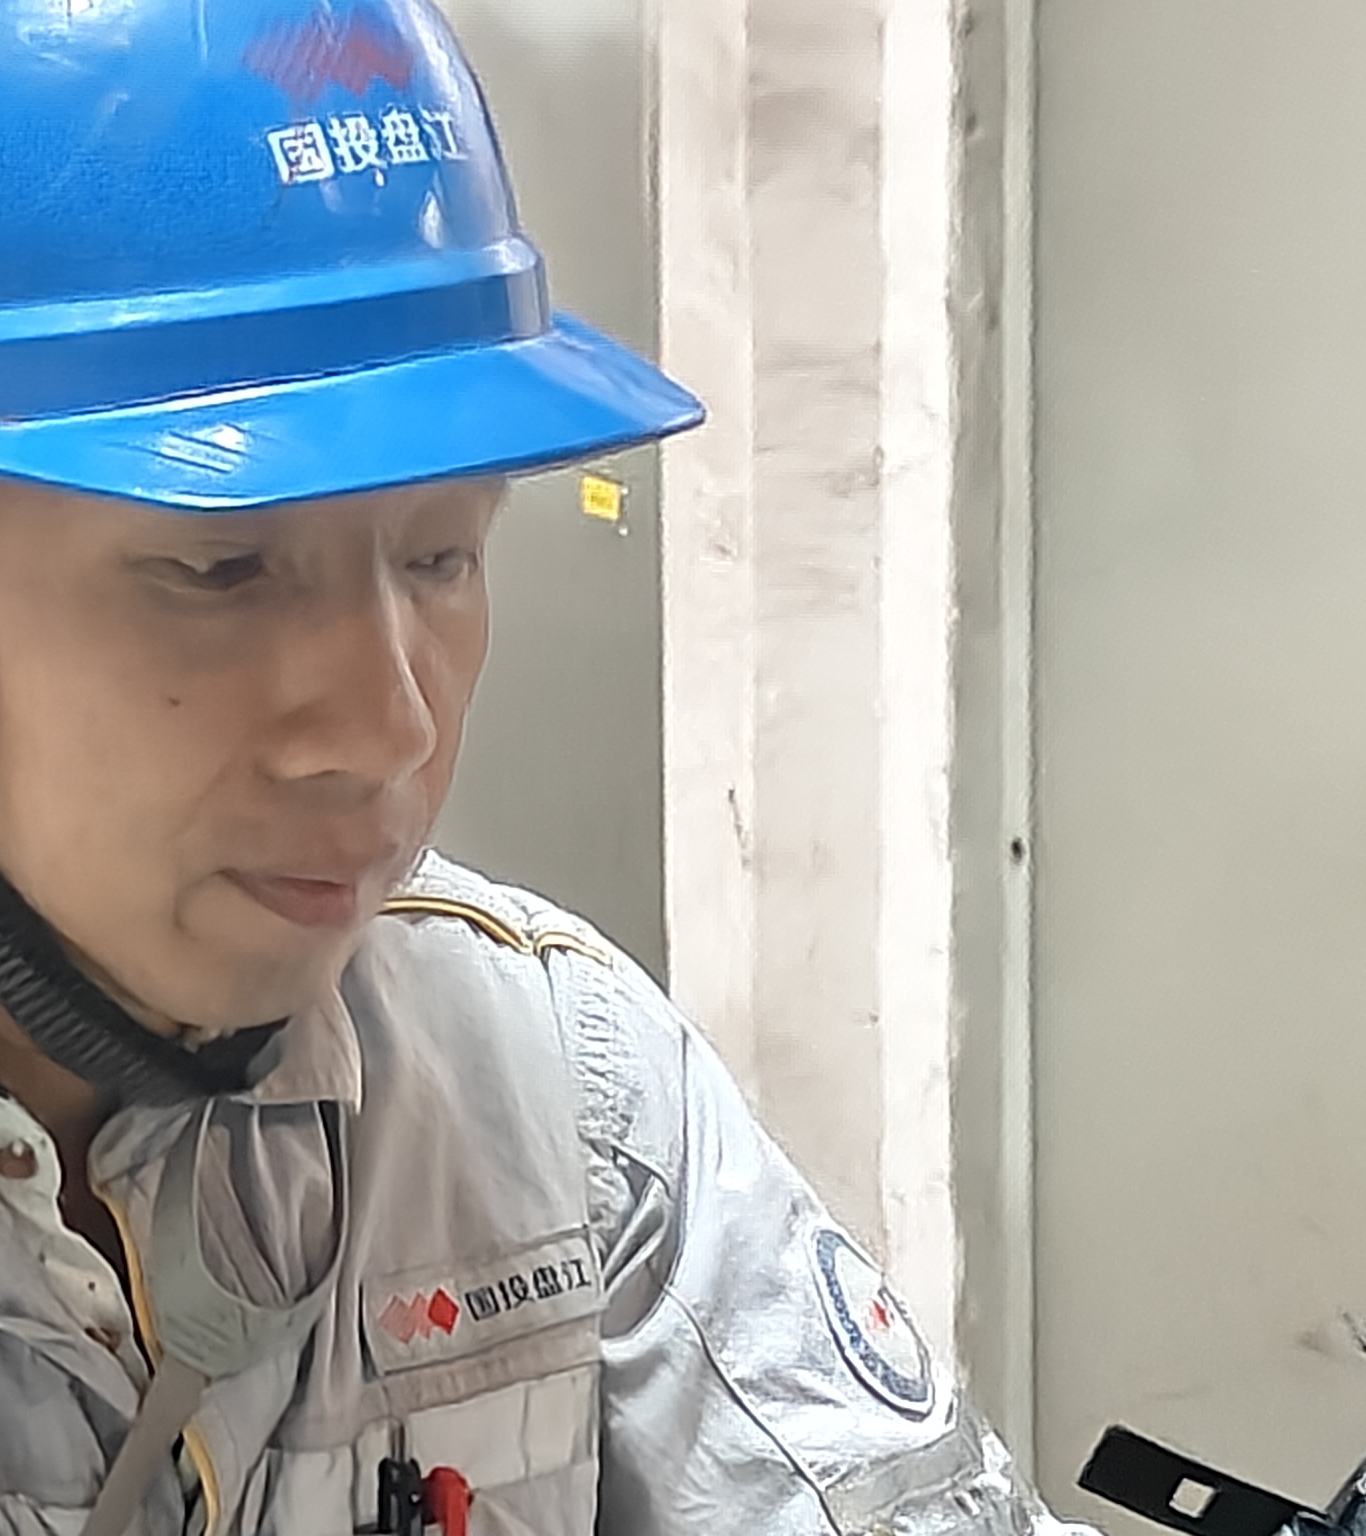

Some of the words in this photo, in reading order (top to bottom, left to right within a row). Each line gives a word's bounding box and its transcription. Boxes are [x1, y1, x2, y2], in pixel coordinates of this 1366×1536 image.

[266, 104, 468, 184] 国投盘江
[464, 1258, 592, 1322] 国投盘江
